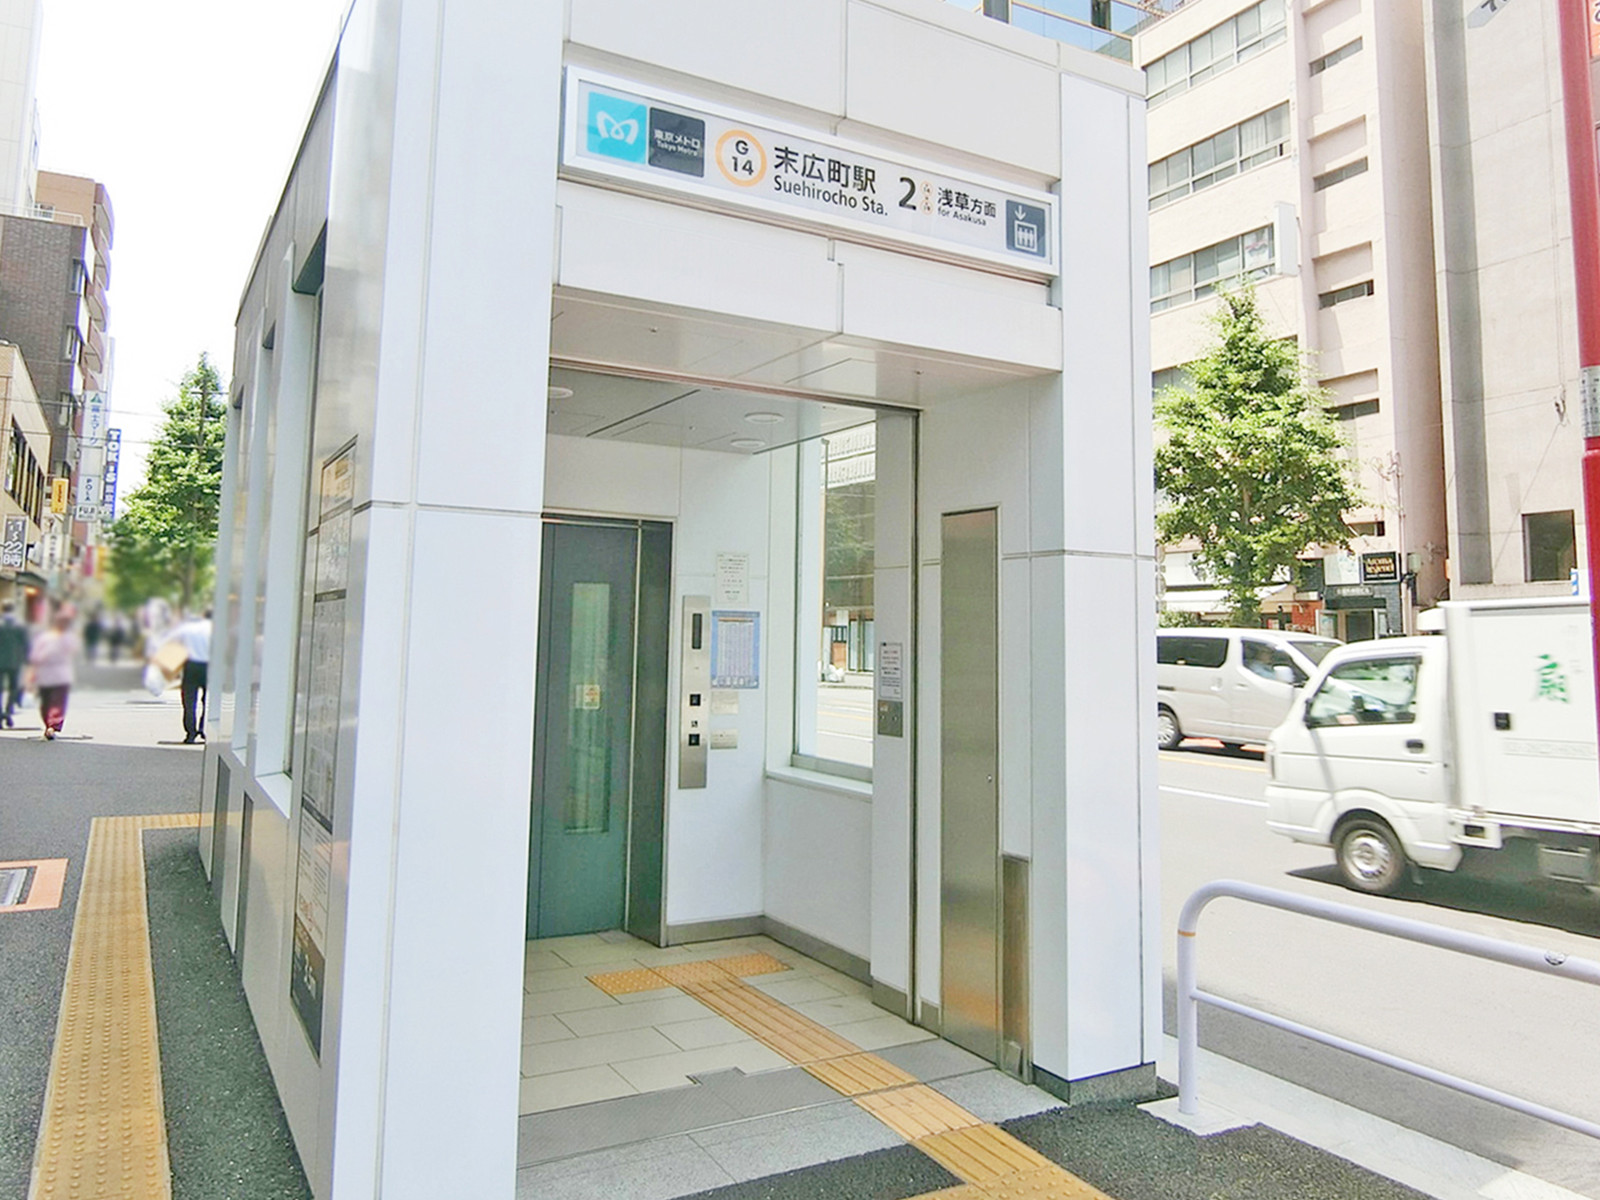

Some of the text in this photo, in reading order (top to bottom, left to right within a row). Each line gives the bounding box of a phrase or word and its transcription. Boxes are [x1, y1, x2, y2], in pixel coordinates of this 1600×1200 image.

[654, 129, 701, 149] 東京メトロ
[657, 140, 698, 156] Tokyo Metro
[735, 139, 749, 155] G
[732, 156, 754, 175] 14
[774, 146, 876, 194] 末広町駅
[774, 174, 857, 209] Suehirocho
[862, 196, 888, 216] Sta.
[898, 177, 917, 211] 2
[938, 187, 996, 218] 浅草方面
[938, 206, 987, 226] for Asakusa
